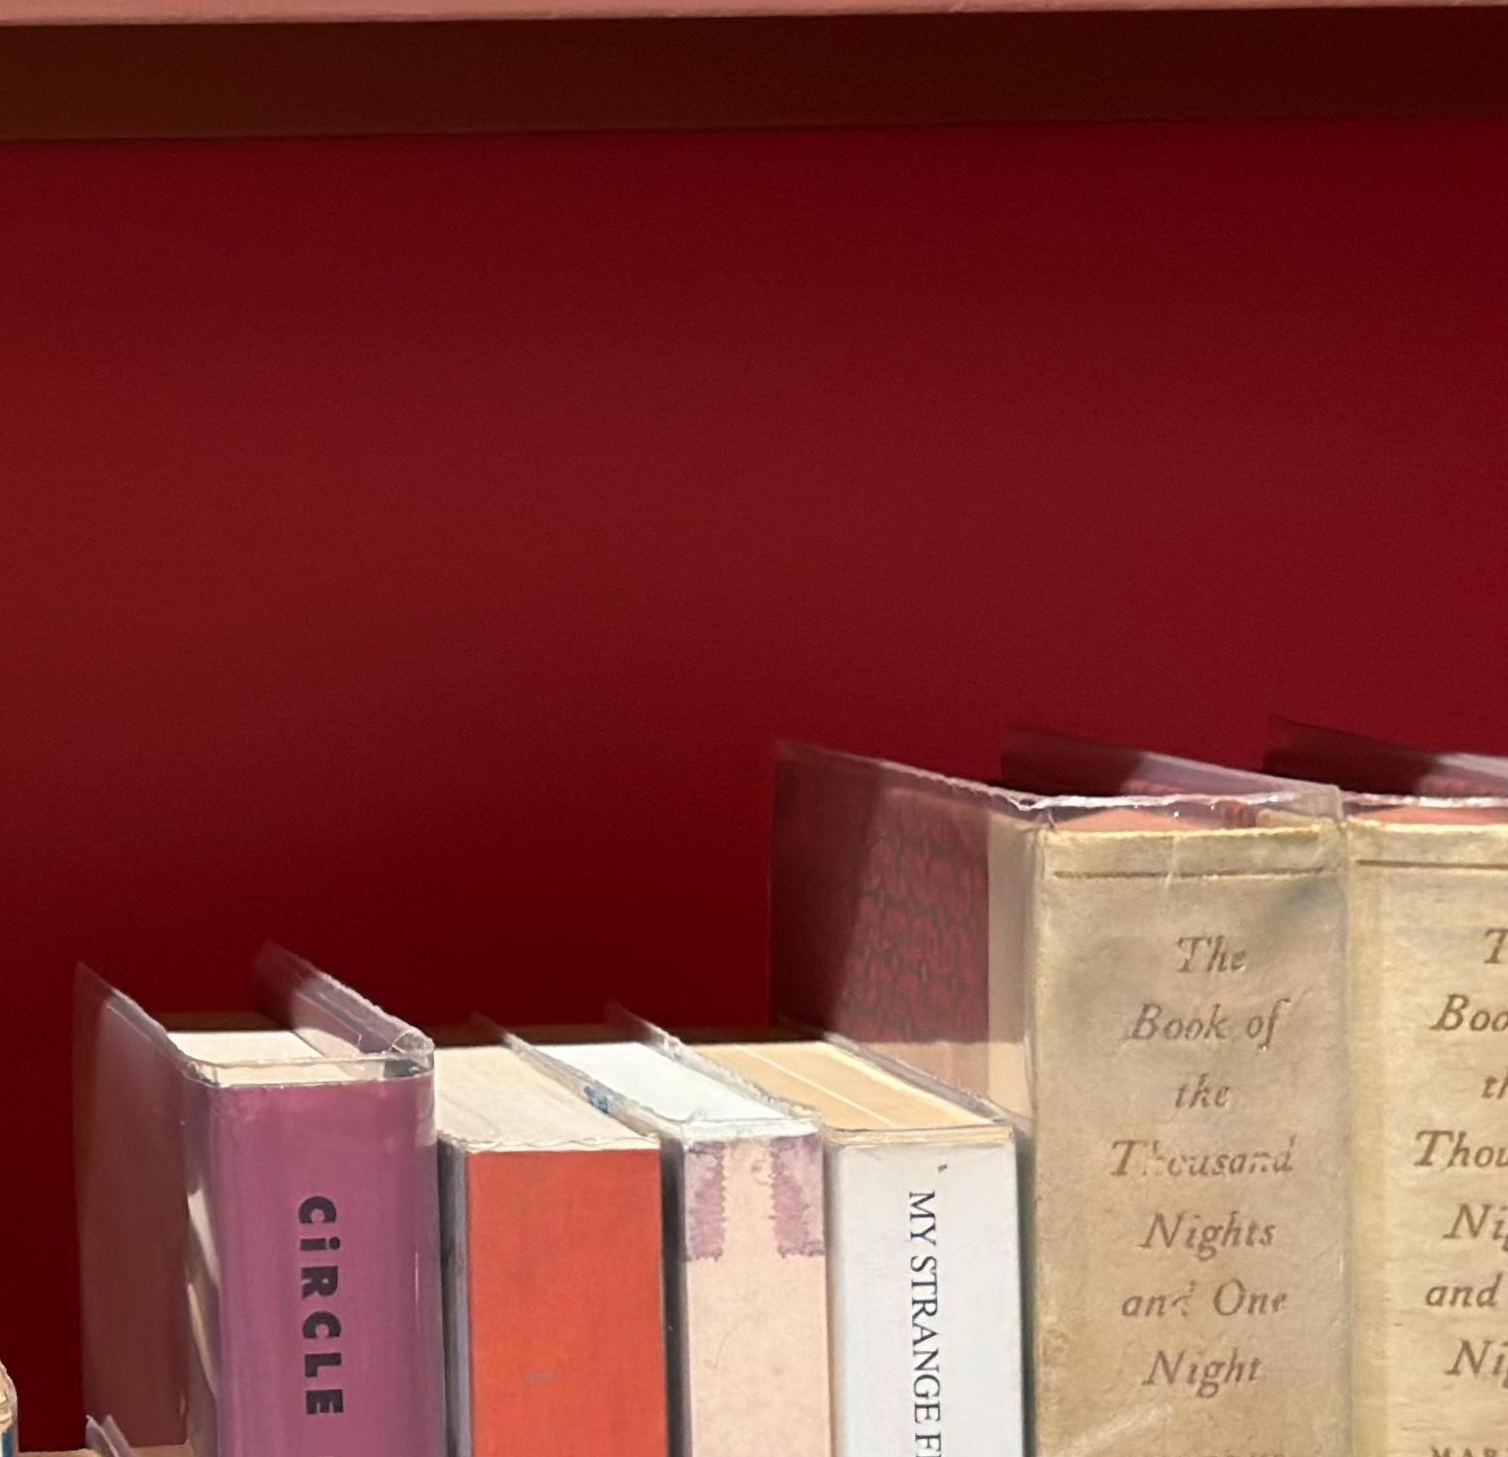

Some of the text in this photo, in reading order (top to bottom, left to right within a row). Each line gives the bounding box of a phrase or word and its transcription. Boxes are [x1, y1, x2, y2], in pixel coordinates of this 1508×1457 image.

[1177, 935, 1247, 973] The
[1127, 999, 1291, 1050] Book of
[1175, 1073, 1230, 1108] the
[909, 1191, 936, 1247] MY
[1140, 1211, 1276, 1262] Nights
[1213, 1278, 1287, 1316] One
[1425, 1272, 1504, 1308] and
[910, 1256, 942, 1423] STRANGE
[1142, 1348, 1262, 1399] Night
